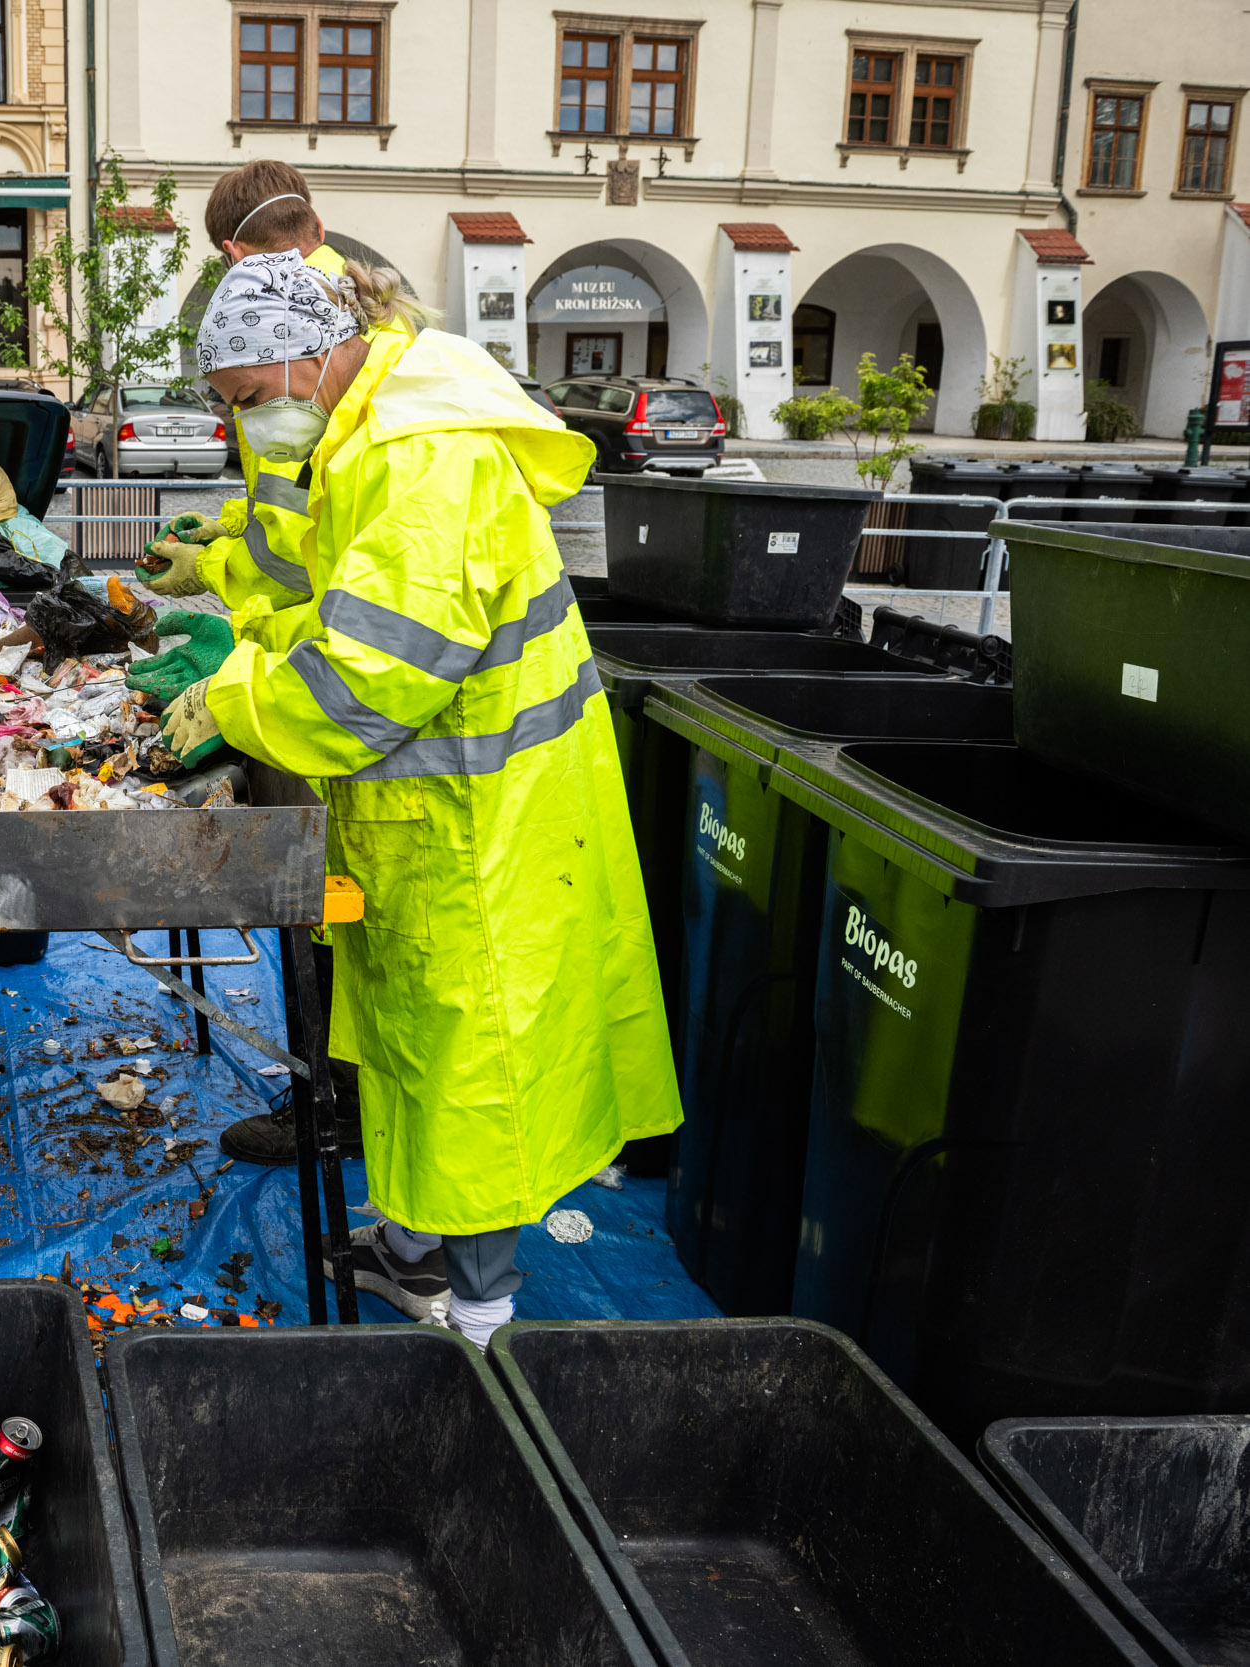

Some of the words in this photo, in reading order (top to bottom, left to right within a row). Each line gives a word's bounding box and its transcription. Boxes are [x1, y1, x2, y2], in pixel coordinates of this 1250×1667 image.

[572, 282, 615, 293] MUZEU
[699, 802, 746, 861] Biopas
[710, 856, 743, 886] SAUBERMACHER
[845, 905, 918, 988] Biopas
[841, 957, 854, 974] PART
[854, 969, 862, 981] OF
[862, 976, 912, 1020] SAUBERMACHER
